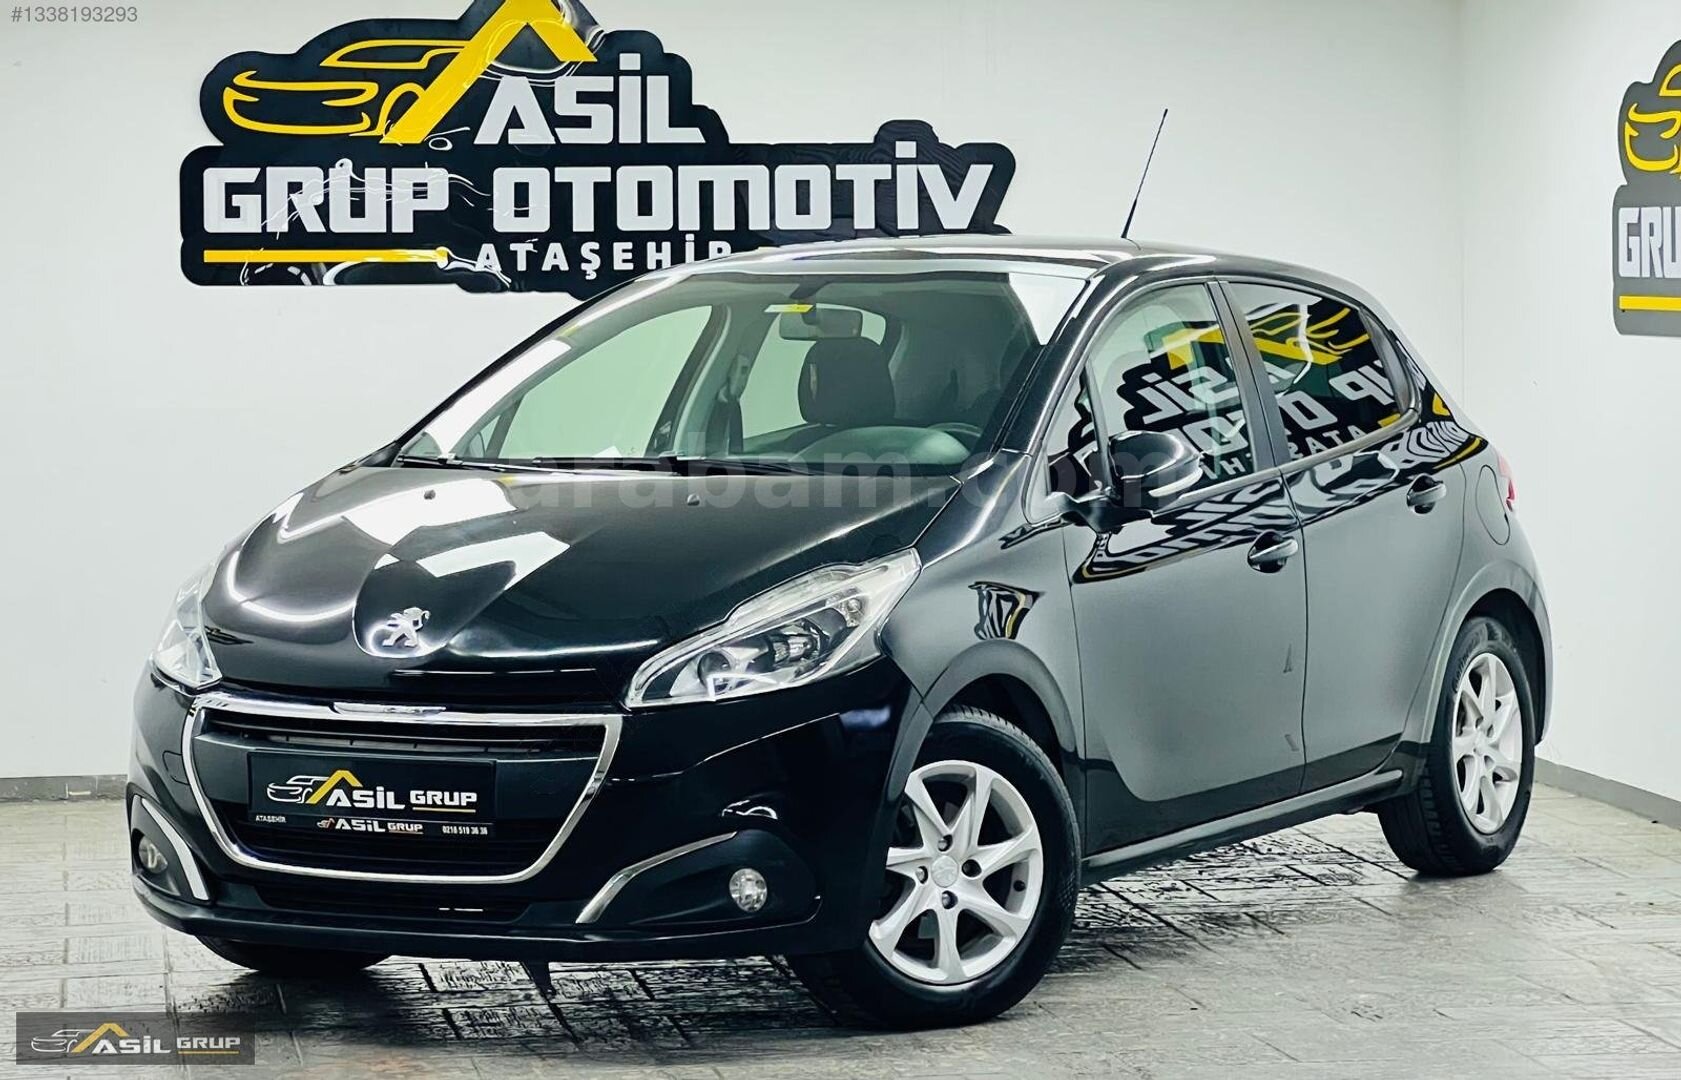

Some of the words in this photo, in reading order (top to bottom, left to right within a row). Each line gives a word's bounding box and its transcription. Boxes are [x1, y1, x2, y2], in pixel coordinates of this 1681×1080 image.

[473, 53, 706, 145] ASİL
[203, 167, 449, 233] GRUP
[493, 141, 994, 232] OTOMOTİV
[326, 786, 405, 810] ASİL
[410, 790, 477, 806] GRUP
[335, 818, 386, 832] ASİL
[387, 822, 423, 832] GRUP
